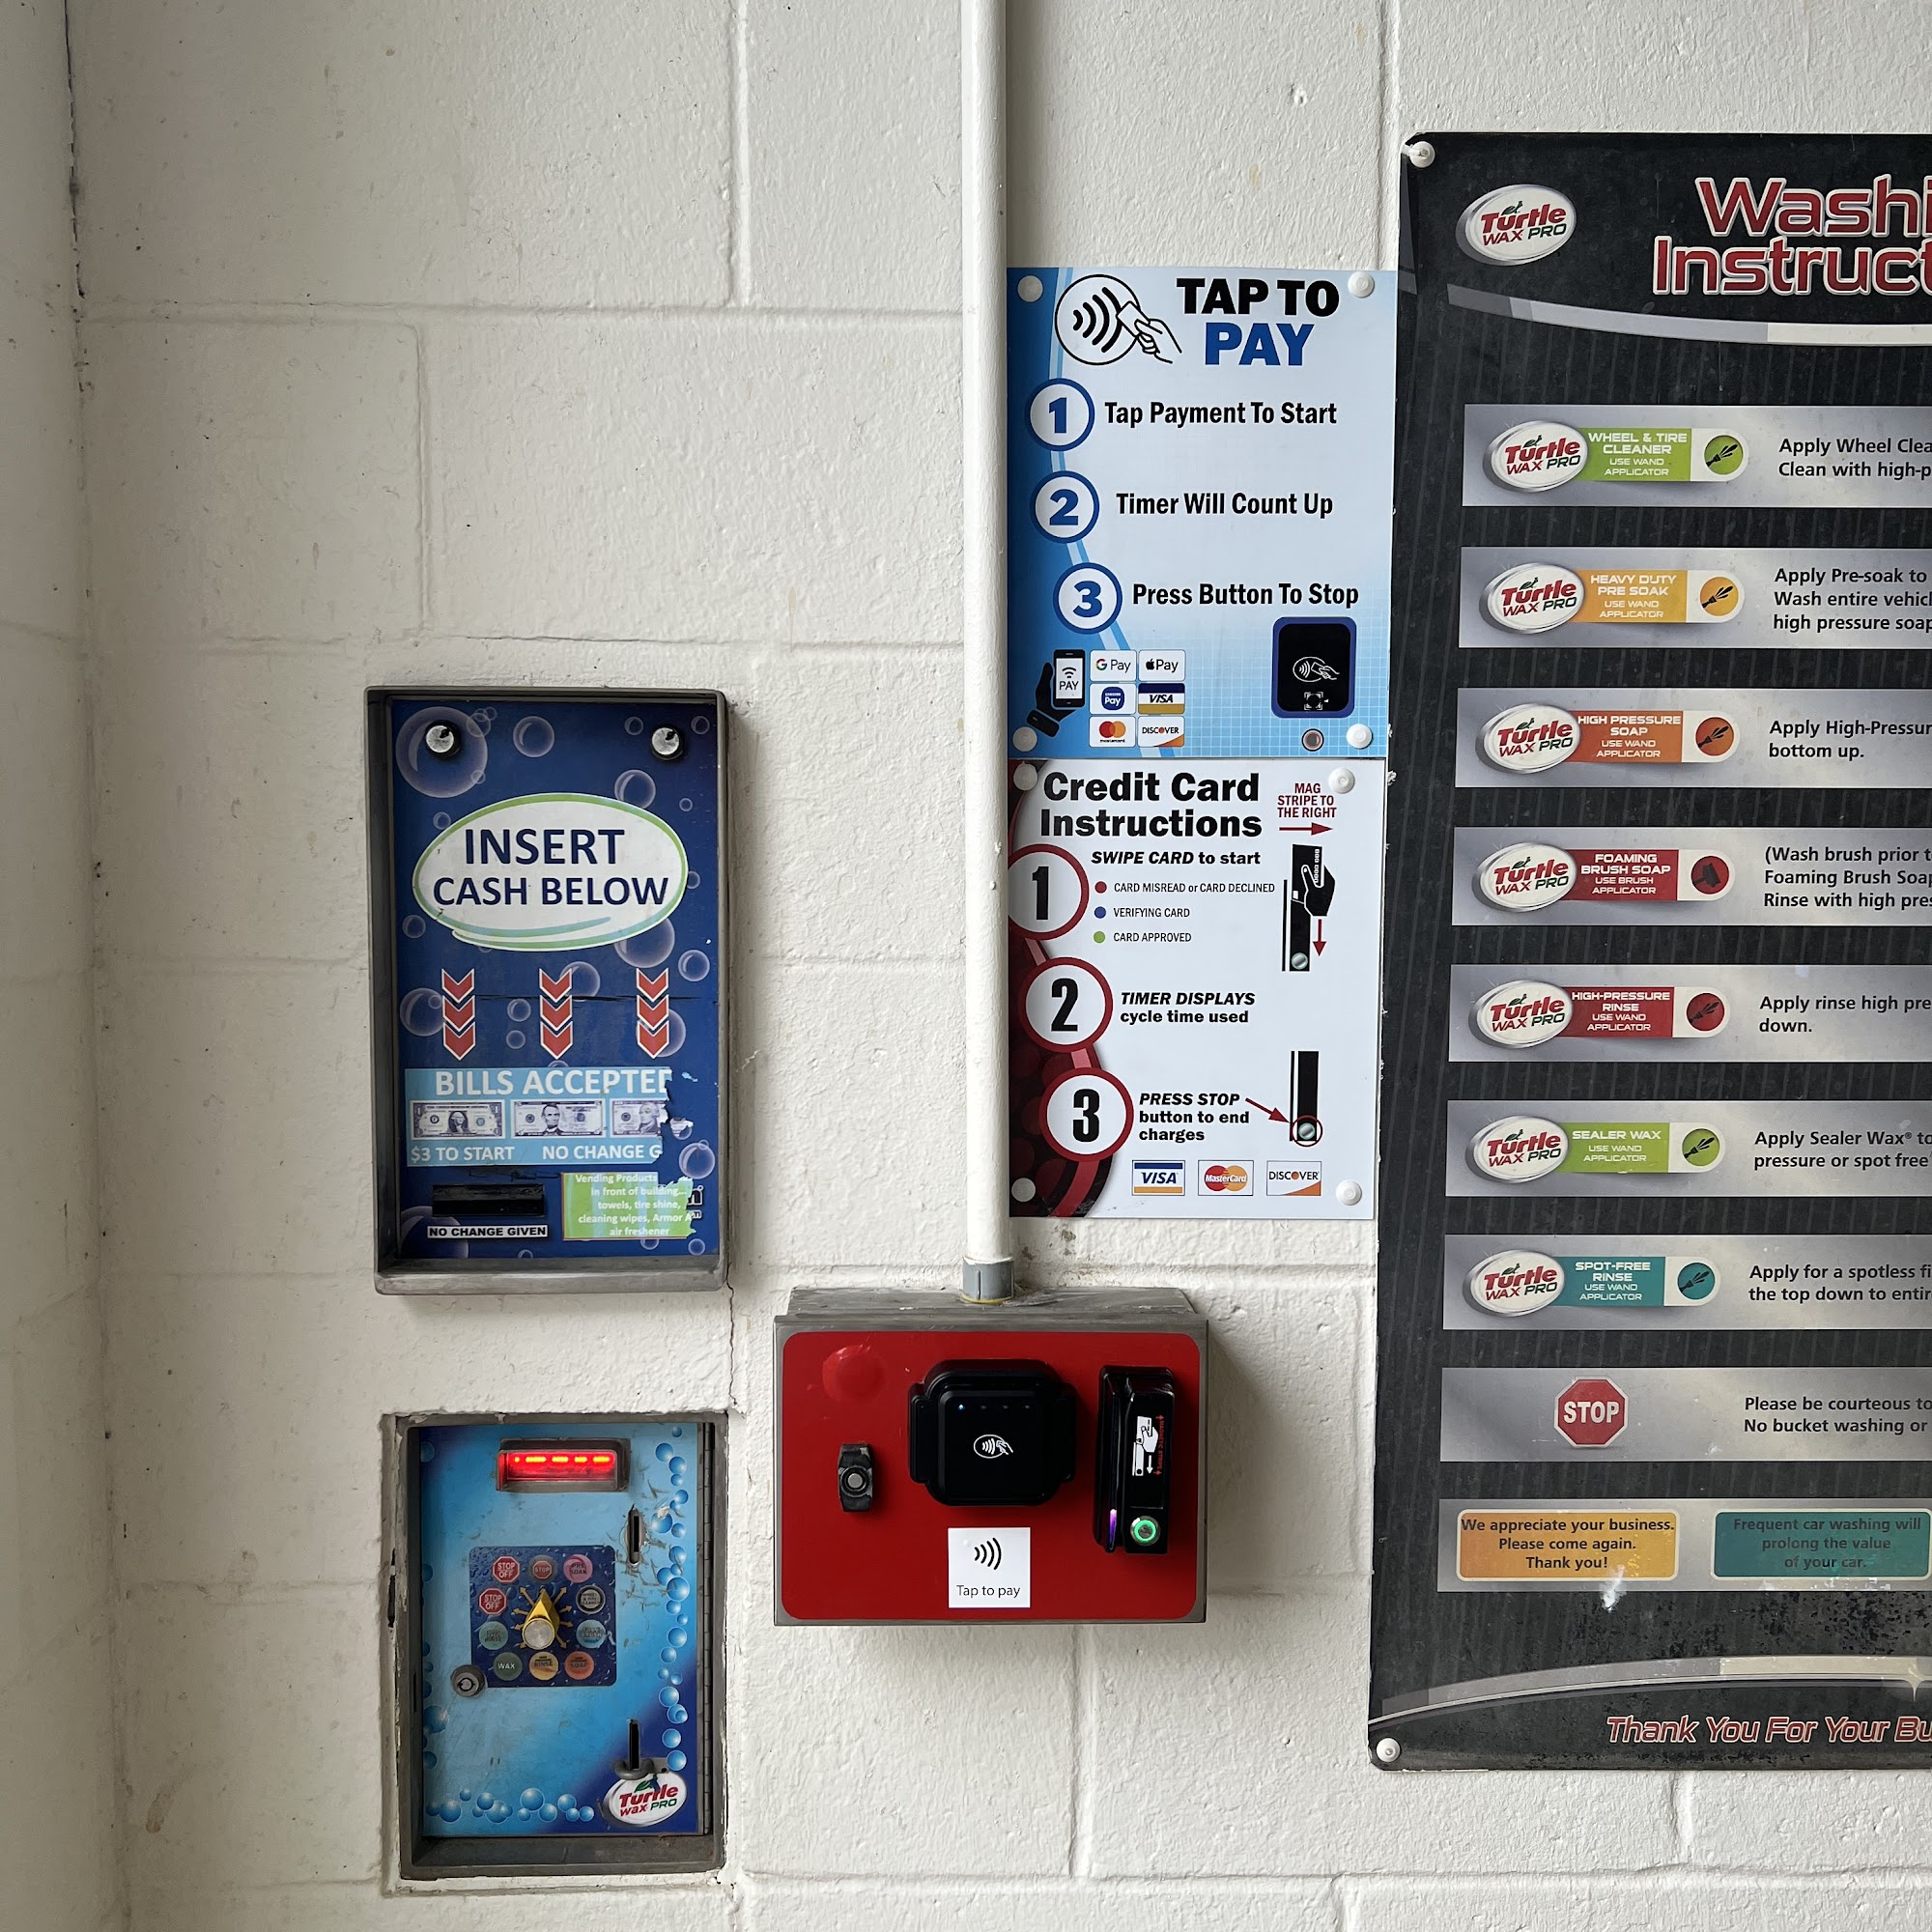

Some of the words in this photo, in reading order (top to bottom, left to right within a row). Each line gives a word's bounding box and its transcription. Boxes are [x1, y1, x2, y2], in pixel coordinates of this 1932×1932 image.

[1177, 278, 1268, 315] TAP
[1277, 279, 1340, 317] TO
[1206, 323, 1314, 366] PAY
[1048, 397, 1067, 434] 1
[1105, 402, 1143, 428] Tap
[1150, 402, 1246, 428] Payment
[1251, 402, 1275, 424] To
[1280, 402, 1337, 424] Start
[1588, 433, 1638, 442] WHEEL
[1642, 433, 1654, 442] &
[1656, 433, 1688, 443] TIRE
[1505, 438, 1580, 464] Turtle
[1603, 444, 1671, 455] CLEANER
[1507, 461, 1543, 475] WAX
[1547, 455, 1581, 469] PRO
[1049, 489, 1079, 526] 2
[1116, 493, 1179, 515] Timer
[1183, 492, 1225, 515] Will
[1232, 493, 1297, 515] Count
[1303, 493, 1333, 519] Up
[1775, 568, 1826, 585] Apply
[1832, 568, 1904, 582] Pre-soak
[1909, 570, 1927, 582] to
[1072, 581, 1102, 617] 3
[1133, 583, 1192, 605] Press
[1199, 583, 1273, 605] Button
[1278, 583, 1302, 605] To
[1308, 583, 1359, 609] Stop
[1110, 659, 1131, 673] Pay
[1155, 659, 1179, 672] Pay
[1059, 681, 1079, 690] PAY
[1104, 696, 1122, 706] Pay
[1149, 695, 1174, 703] VISA
[1769, 743, 1832, 757] bottom
[1837, 747, 1864, 761] up.
[1043, 773, 1160, 802] Credit
[1171, 773, 1259, 802] Card
[1294, 782, 1321, 794] MAG
[1277, 796, 1318, 806] STRIPE
[1321, 796, 1335, 806] TO
[1277, 807, 1299, 818] THE
[1302, 807, 1337, 818] RIGHT
[1040, 809, 1263, 838] Instructions
[465, 829, 625, 865] INSERT
[1595, 854, 1657, 864] FOAMING
[1580, 865, 1630, 874] BRUSH
[1633, 865, 1671, 874] SOAP
[434, 877, 527, 905] CASH
[541, 877, 669, 905] BELOW
[1032, 866, 1049, 921] 1
[1091, 851, 1144, 864] SWIPE
[1148, 851, 1194, 864] CARD
[1198, 852, 1215, 864] to
[1219, 852, 1261, 865] start
[1114, 883, 1140, 893] CARD
[1143, 883, 1186, 893] MISREAD
[1200, 883, 1226, 893] CARD
[1228, 883, 1275, 893] DECLINED
[1114, 908, 1161, 918] VERIFYING
[1164, 908, 1190, 918] CARD
[1114, 932, 1139, 943] CARD
[1142, 932, 1192, 943] APPROVED
[1572, 992, 1670, 1001] HIGH-PRESSURE
[1051, 979, 1079, 1032] 2
[1121, 992, 1171, 1006] TIMER
[1176, 992, 1256, 1006] DISPLAYS
[1602, 1003, 1639, 1011] RINSE
[1121, 1010, 1162, 1025] cycle
[1167, 1009, 1206, 1022] time
[1208, 1009, 1249, 1023] used
[1759, 1018, 1812, 1033] down.
[436, 1070, 514, 1095] BILLS
[1072, 1089, 1100, 1142] 3
[1139, 1093, 1193, 1106] PRESS
[1197, 1093, 1240, 1106] STOP
[1139, 1111, 1192, 1123] button
[1197, 1112, 1213, 1123] to
[1218, 1111, 1249, 1123] end
[1139, 1128, 1205, 1144] charges
[1572, 1130, 1626, 1140] SEALER
[1630, 1130, 1662, 1140] WAX
[411, 1146, 431, 1163] $3
[436, 1147, 459, 1161] TO
[464, 1146, 516, 1161] START
[542, 1146, 568, 1160] NO
[573, 1145, 639, 1159] CHANGE
[1754, 1156, 1826, 1171] pressure
[1831, 1156, 1849, 1167] or
[1854, 1154, 1890, 1171] spot
[1895, 1152, 1929, 1167] free
[575, 1175, 614, 1184] Vending
[616, 1174, 658, 1182] Products
[1141, 1172, 1177, 1184] VISA
[1205, 1173, 1248, 1185] MasterCard
[1268, 1170, 1320, 1181] DISCOVER
[603, 1187, 627, 1196] front
[628, 1187, 639, 1196] of
[598, 1201, 633, 1210] towels,
[634, 1201, 651, 1209] tire
[653, 1201, 681, 1210] shine,
[579, 1213, 618, 1225] cleaning
[620, 1214, 650, 1224] wipes,
[428, 1228, 447, 1236] NO
[451, 1228, 504, 1236] CHANGE
[507, 1227, 547, 1236] GIVEN
[610, 1227, 623, 1236] air
[624, 1227, 670, 1236] freshener
[1575, 1262, 1651, 1271] SPOT-FREE
[1592, 1273, 1633, 1282] RINSE
[1563, 1401, 1620, 1424] STOP
[1744, 1419, 1767, 1432] No
[1773, 1418, 1829, 1433] bucket
[1834, 1418, 1904, 1435] washing
[1910, 1421, 1928, 1432] or
[1462, 1520, 1486, 1531] We
[1490, 1519, 1568, 1535] appreciate
[1571, 1521, 1605, 1535] your
[1609, 1518, 1675, 1531] business.
[1498, 1538, 1545, 1549] Please
[1548, 1541, 1589, 1549] come
[1592, 1538, 1636, 1553] again.
[497, 1562, 516, 1571] STOP
[1525, 1556, 1572, 1569] Thank
[1575, 1556, 1608, 1573] you!
[956, 1585, 979, 1599] Tap
[982, 1586, 995, 1596] to
[998, 1587, 1021, 1599] pay
[1606, 1715, 1698, 1743] Thank
[1705, 1717, 1759, 1743] You
[1766, 1717, 1817, 1743] For
[1823, 1717, 1890, 1743] Your
[650, 1799, 677, 1810] PRO
